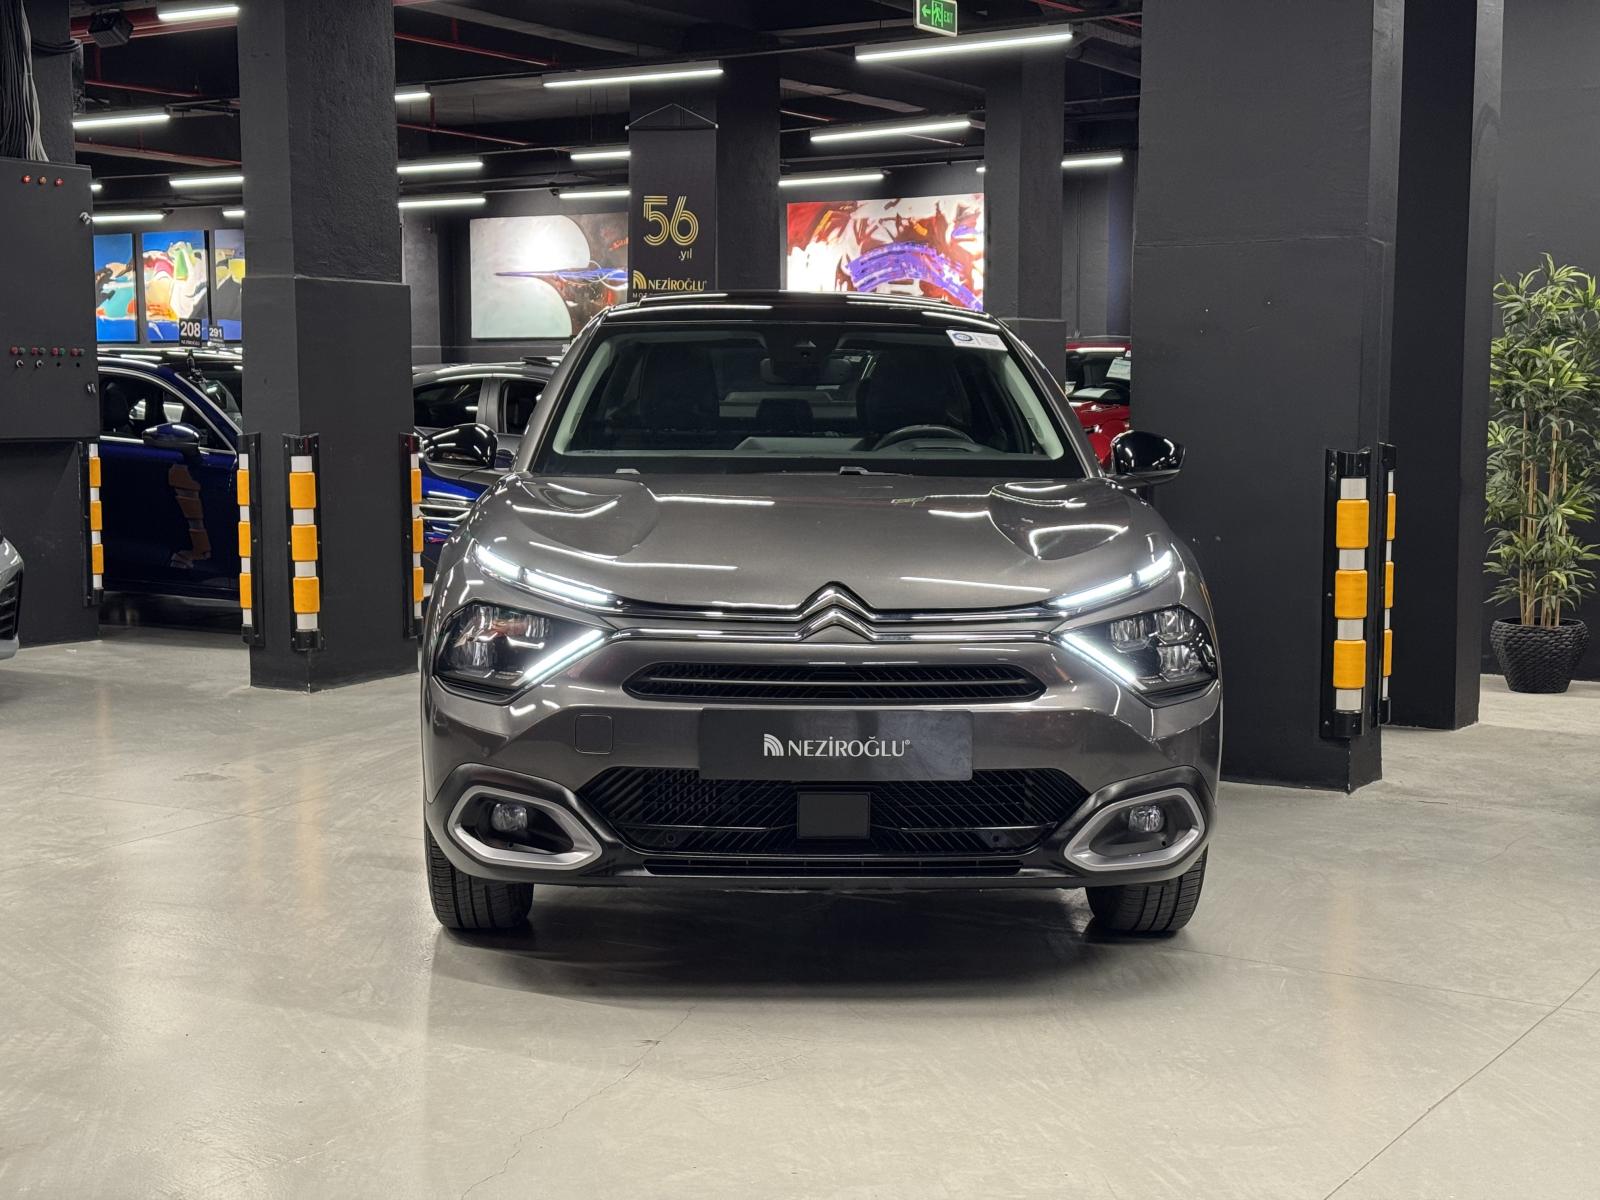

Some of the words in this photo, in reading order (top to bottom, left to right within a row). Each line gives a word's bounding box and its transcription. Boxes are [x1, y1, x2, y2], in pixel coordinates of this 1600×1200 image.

[643, 195, 699, 246] 56
[180, 321, 201, 338] 208
[209, 327, 223, 338] 291
[788, 736, 905, 758] NEZİROĞLU
